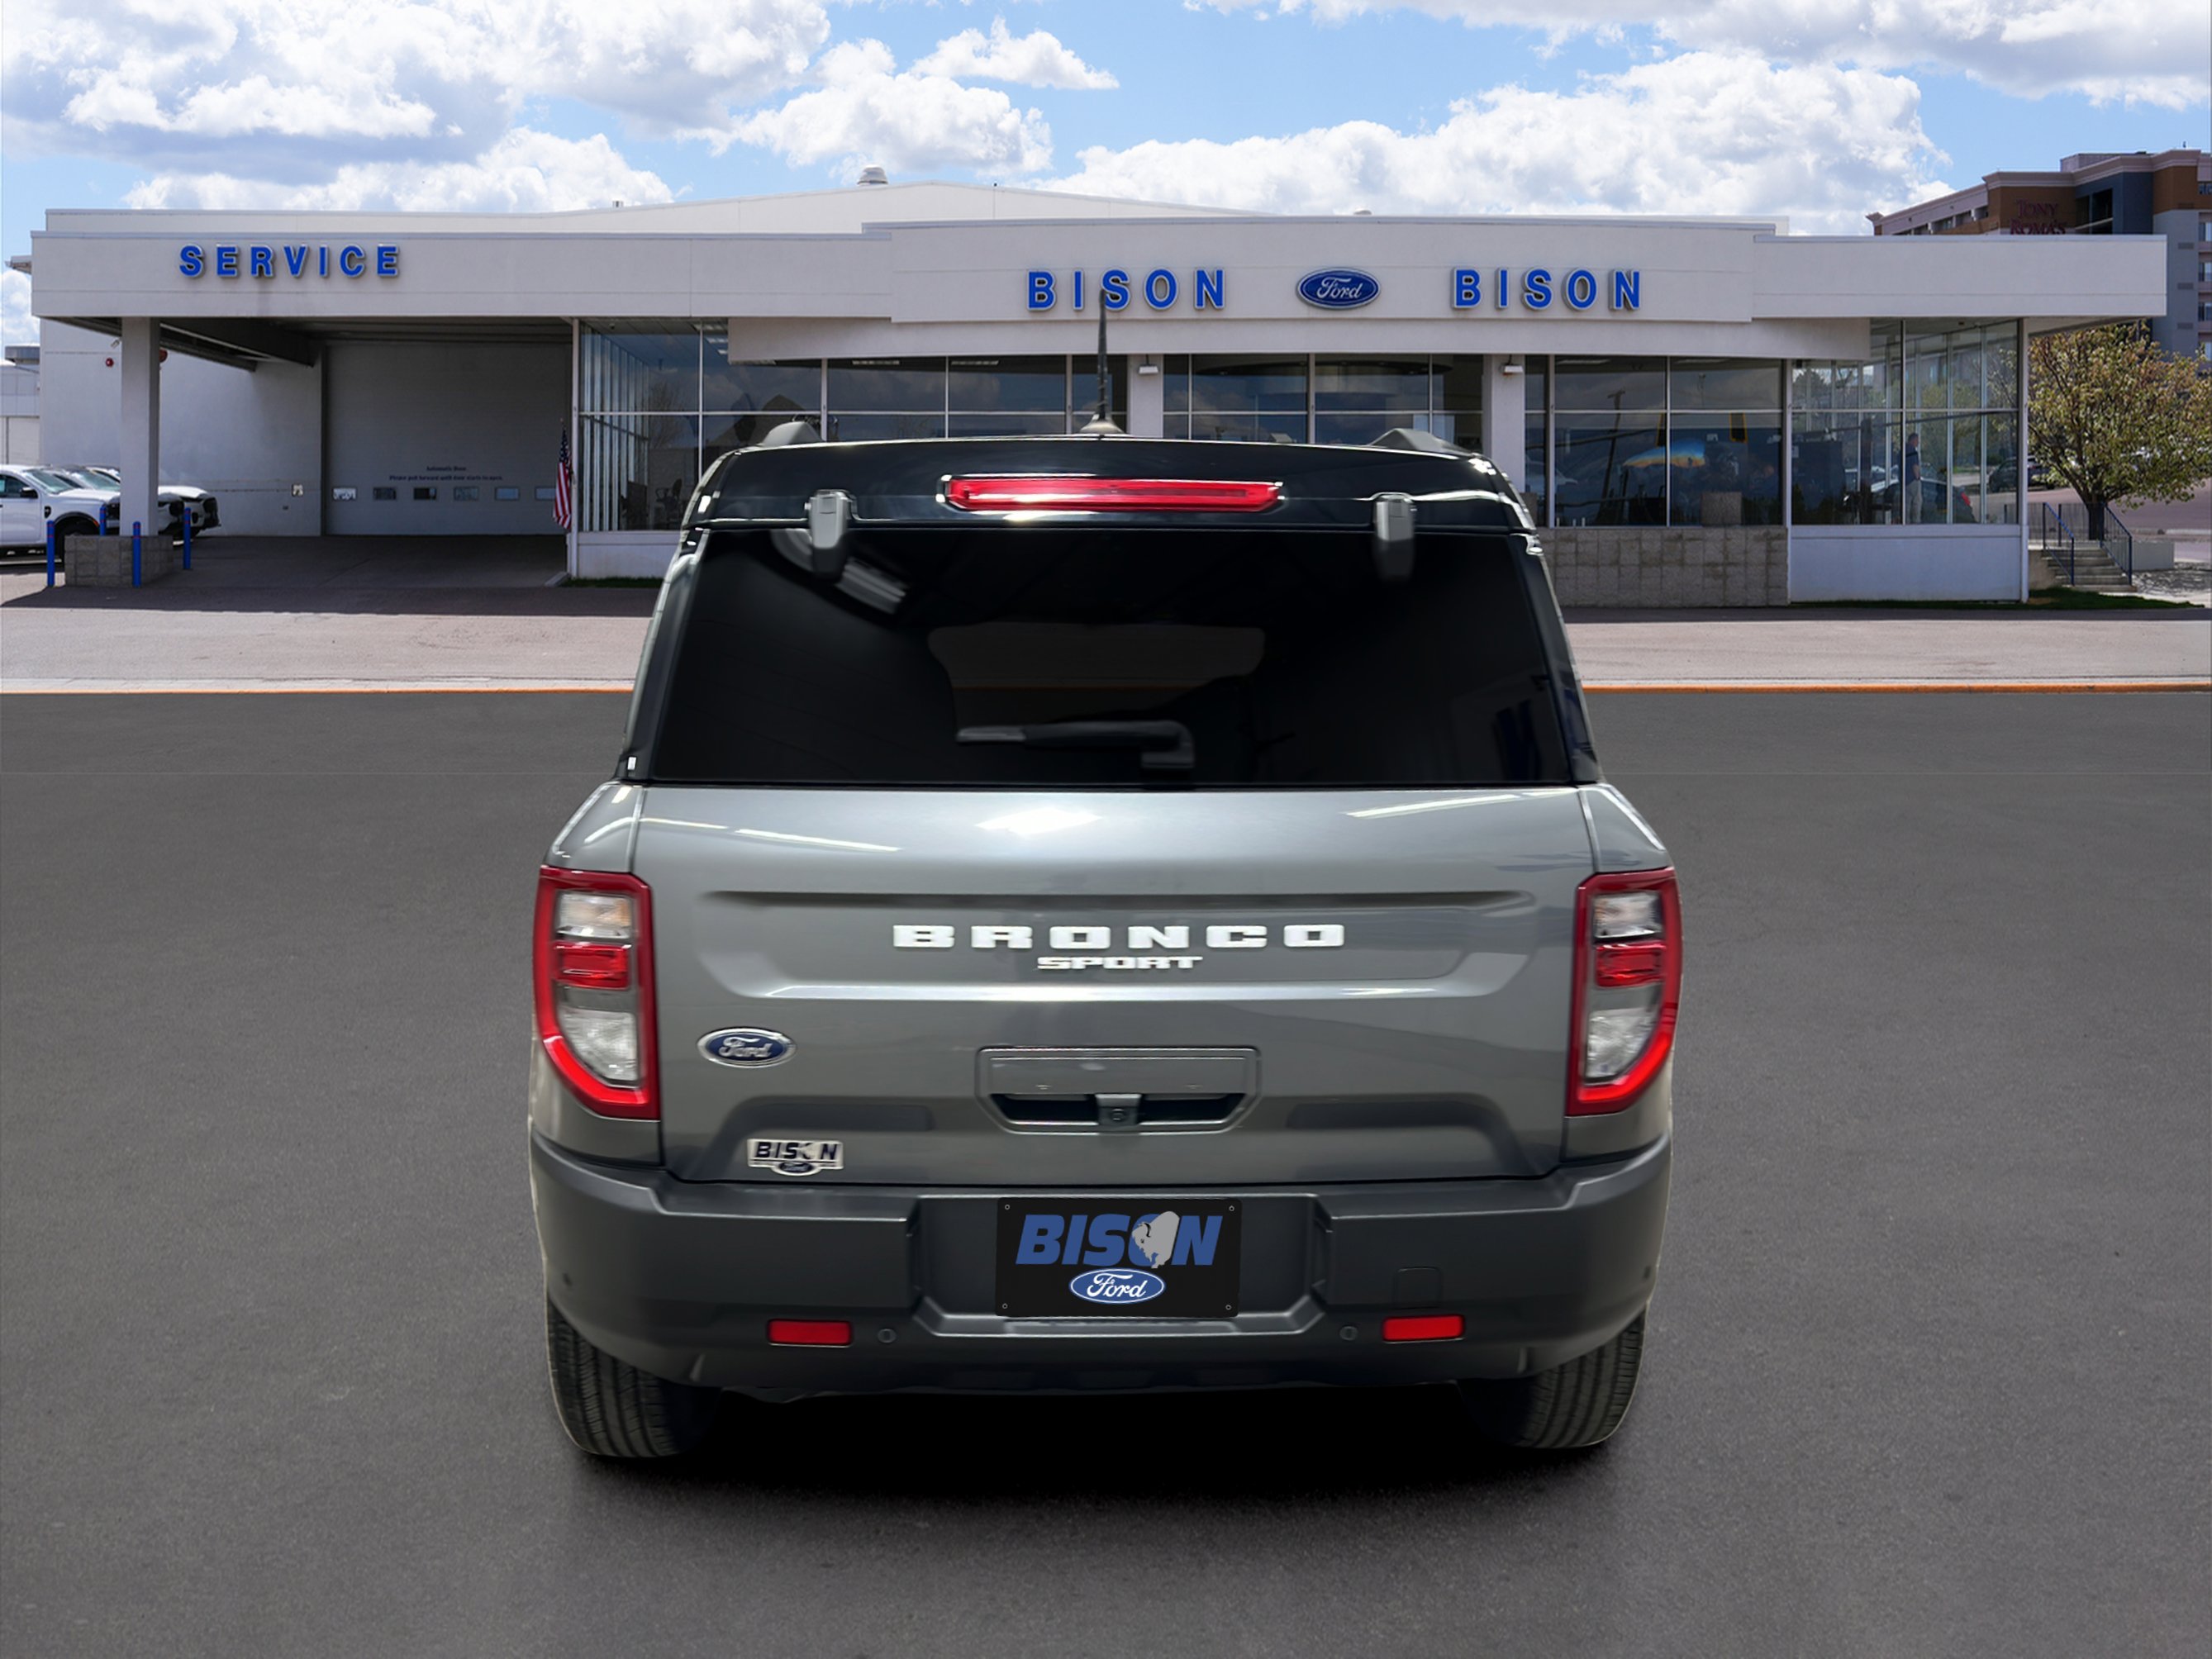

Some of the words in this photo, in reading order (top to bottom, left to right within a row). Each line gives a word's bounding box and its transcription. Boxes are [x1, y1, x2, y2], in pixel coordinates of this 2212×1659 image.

[2015, 198, 2058, 216] TONY
[178, 244, 399, 278] SERVICE
[1026, 269, 1225, 311] BISON
[1315, 277, 1363, 299] Ford
[1453, 268, 1641, 311] BISON
[892, 924, 1345, 949] BRONCO
[1036, 955, 1203, 970] SPORT
[718, 1036, 773, 1058] Ford
[1086, 1272, 1149, 1298] Ford
